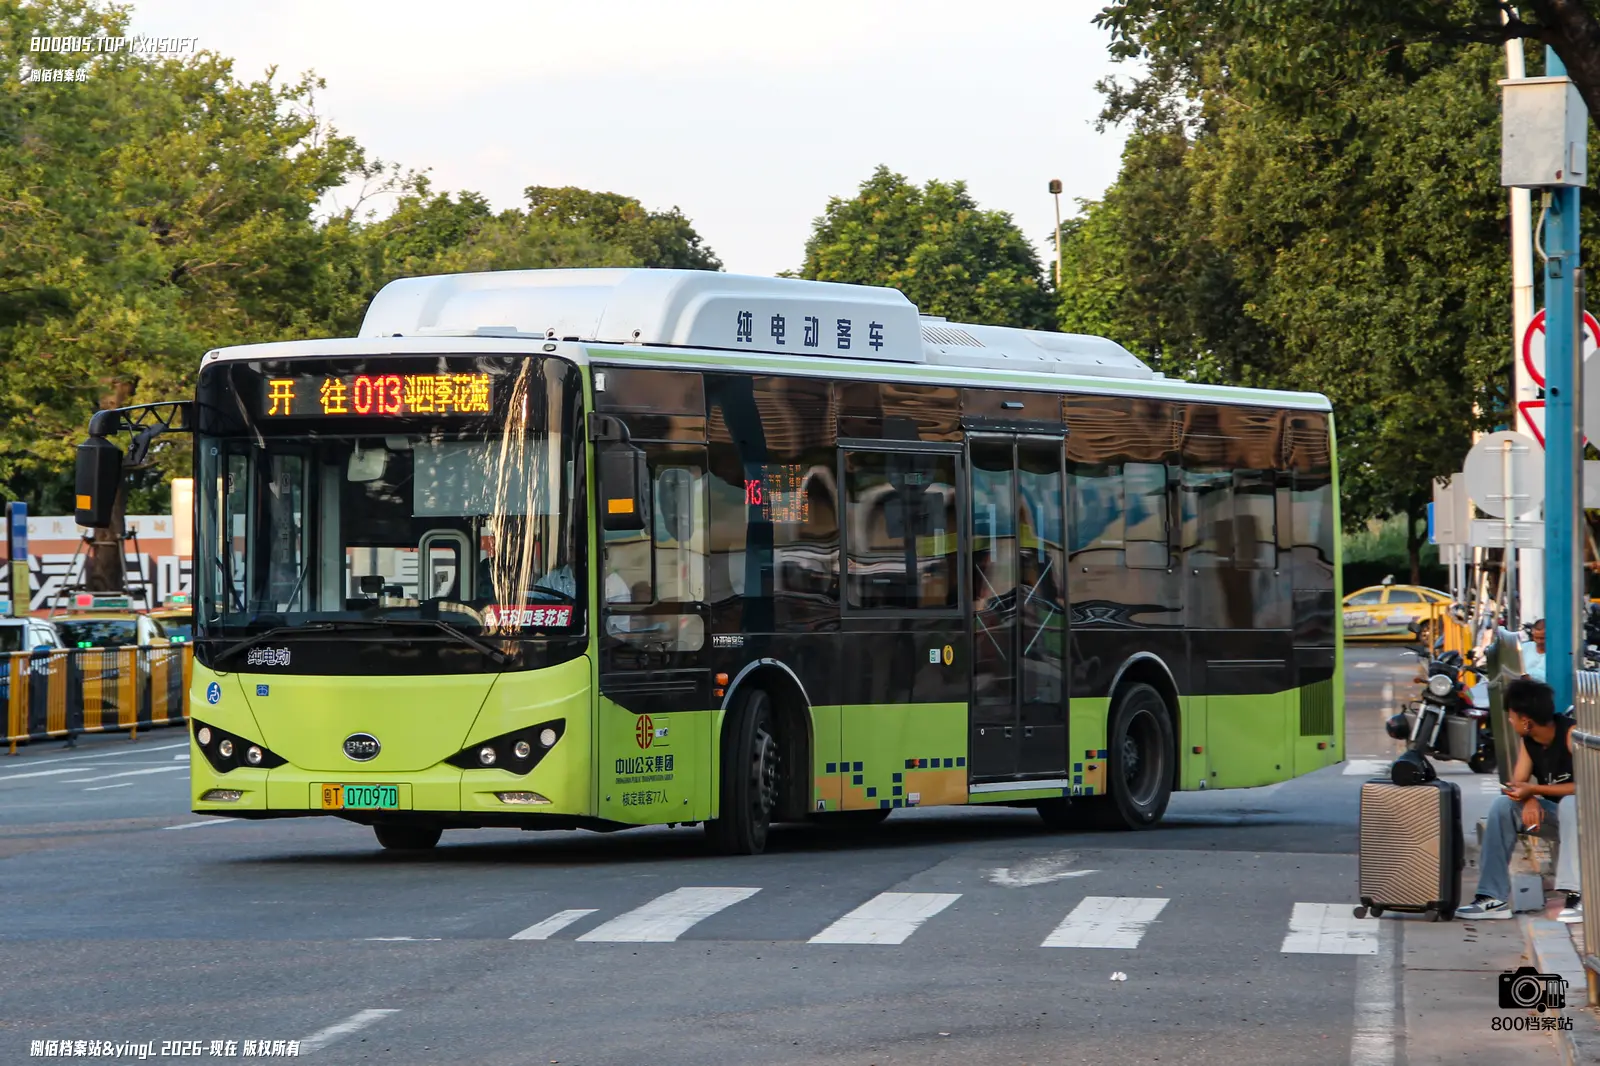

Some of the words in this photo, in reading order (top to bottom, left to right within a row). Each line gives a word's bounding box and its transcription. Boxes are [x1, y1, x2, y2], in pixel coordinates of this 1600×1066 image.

[736, 311, 884, 351] 纯电动客车
[354, 375, 402, 414] 013
[247, 647, 291, 666] 纯电动
[615, 754, 674, 775] 中山公交集团
[622, 789, 669, 807] 核定载客77人
